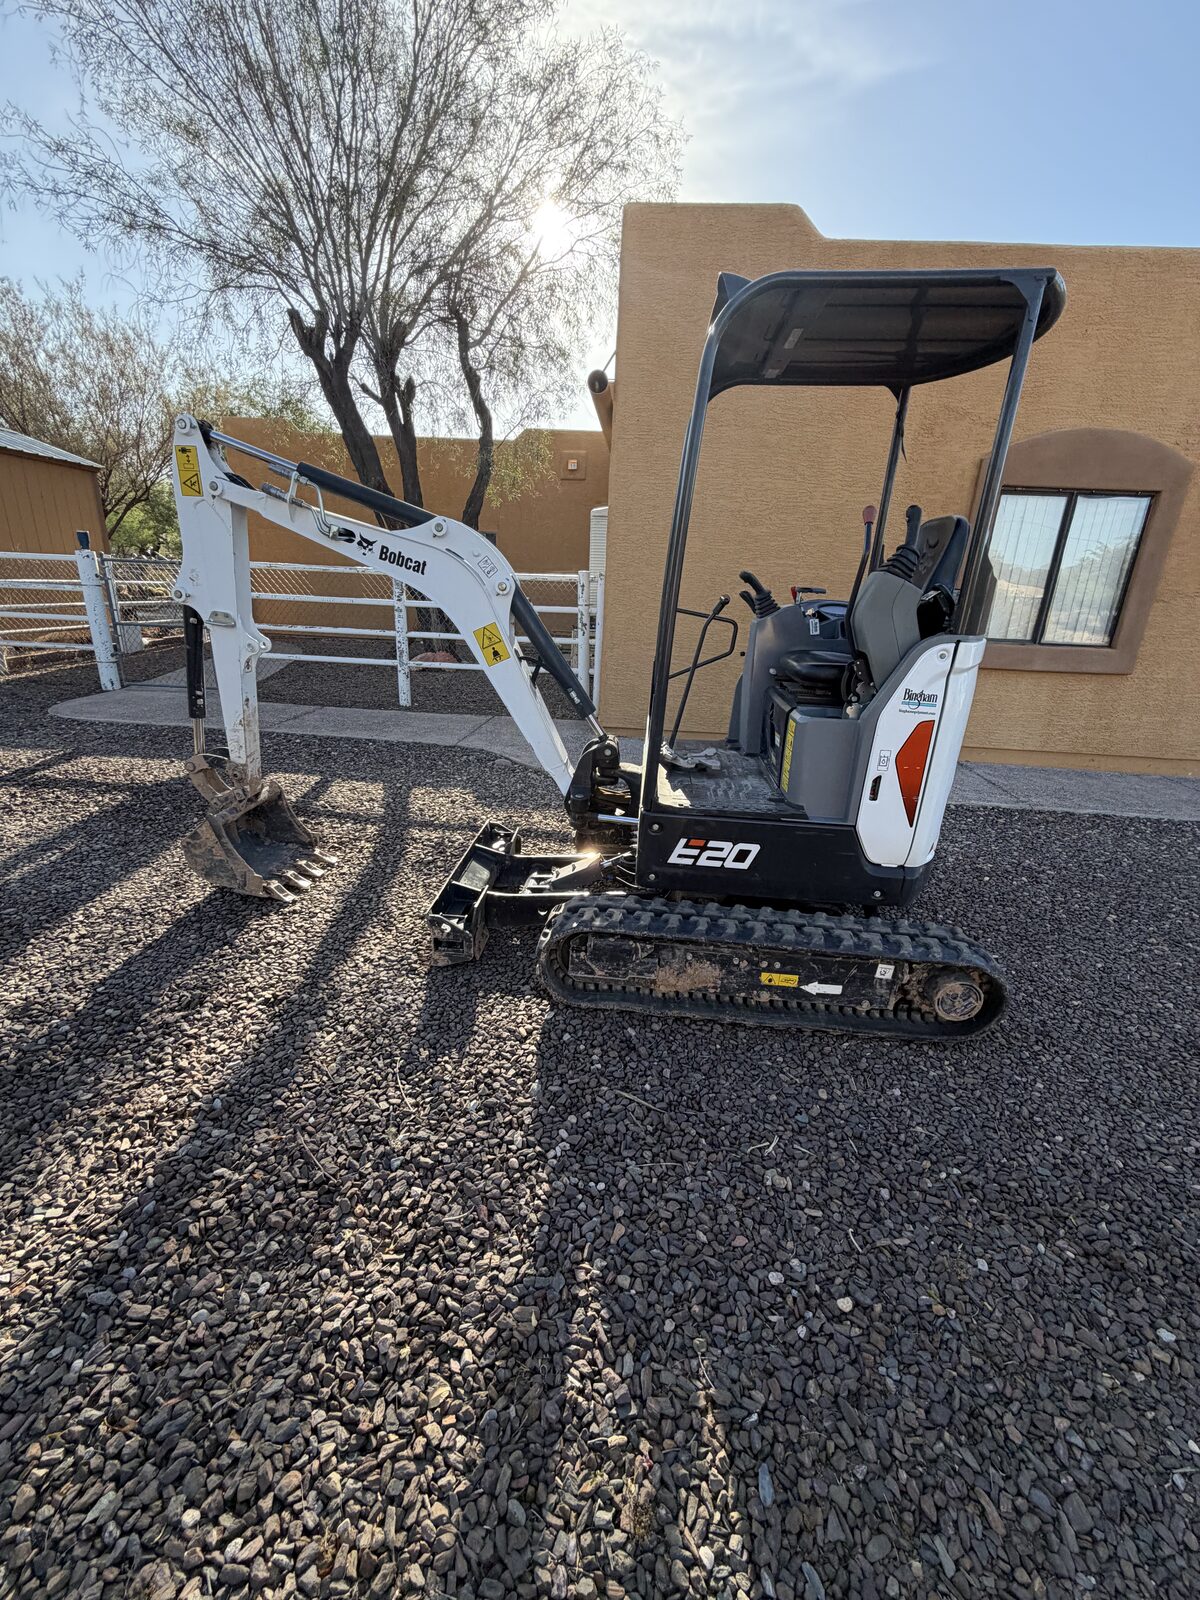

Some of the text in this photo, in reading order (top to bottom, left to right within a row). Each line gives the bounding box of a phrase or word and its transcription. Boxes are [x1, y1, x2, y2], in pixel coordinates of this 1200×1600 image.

[379, 545, 427, 576] Bobcat
[903, 688, 938, 709] Bingham
[667, 838, 761, 870] E20
